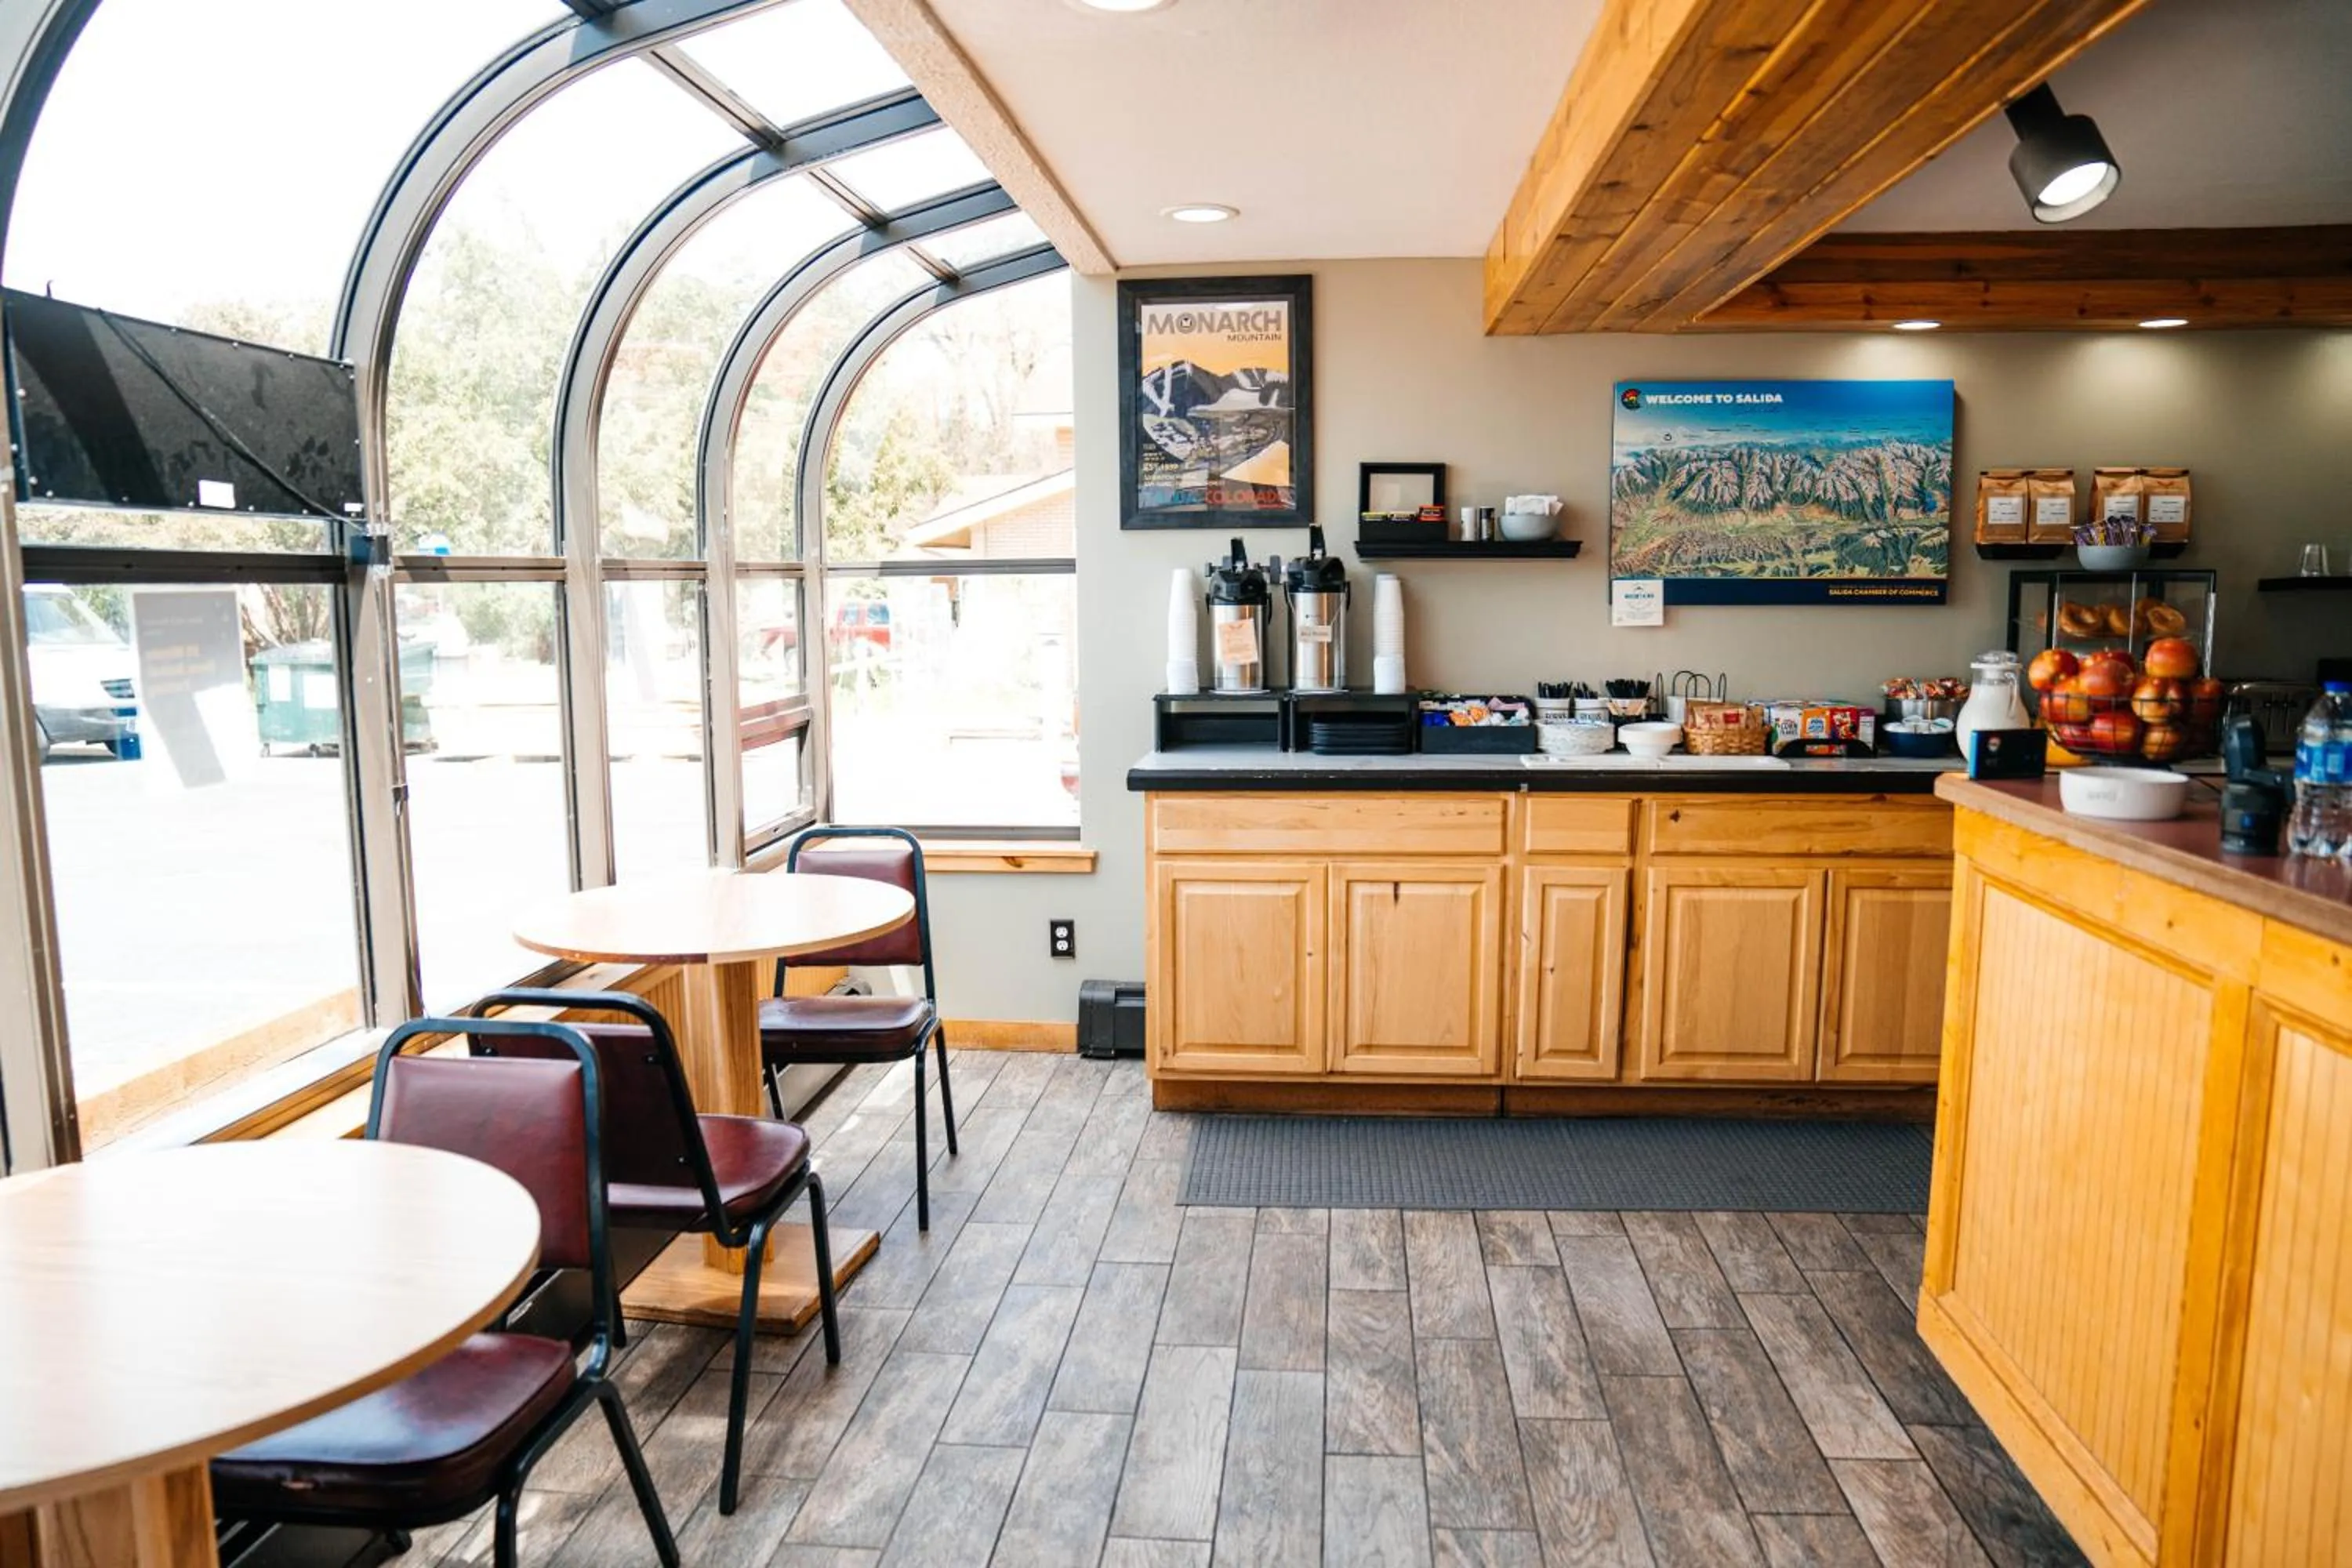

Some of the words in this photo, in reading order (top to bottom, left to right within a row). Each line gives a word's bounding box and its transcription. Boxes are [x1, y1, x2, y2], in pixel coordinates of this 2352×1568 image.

[1147, 310, 1282, 335] MONARCH
[1227, 333, 1282, 343] MOUNTAIN
[1646, 394, 1713, 404] WELCOME
[1716, 394, 1733, 403] TO
[1736, 394, 1783, 403] SALIDA
